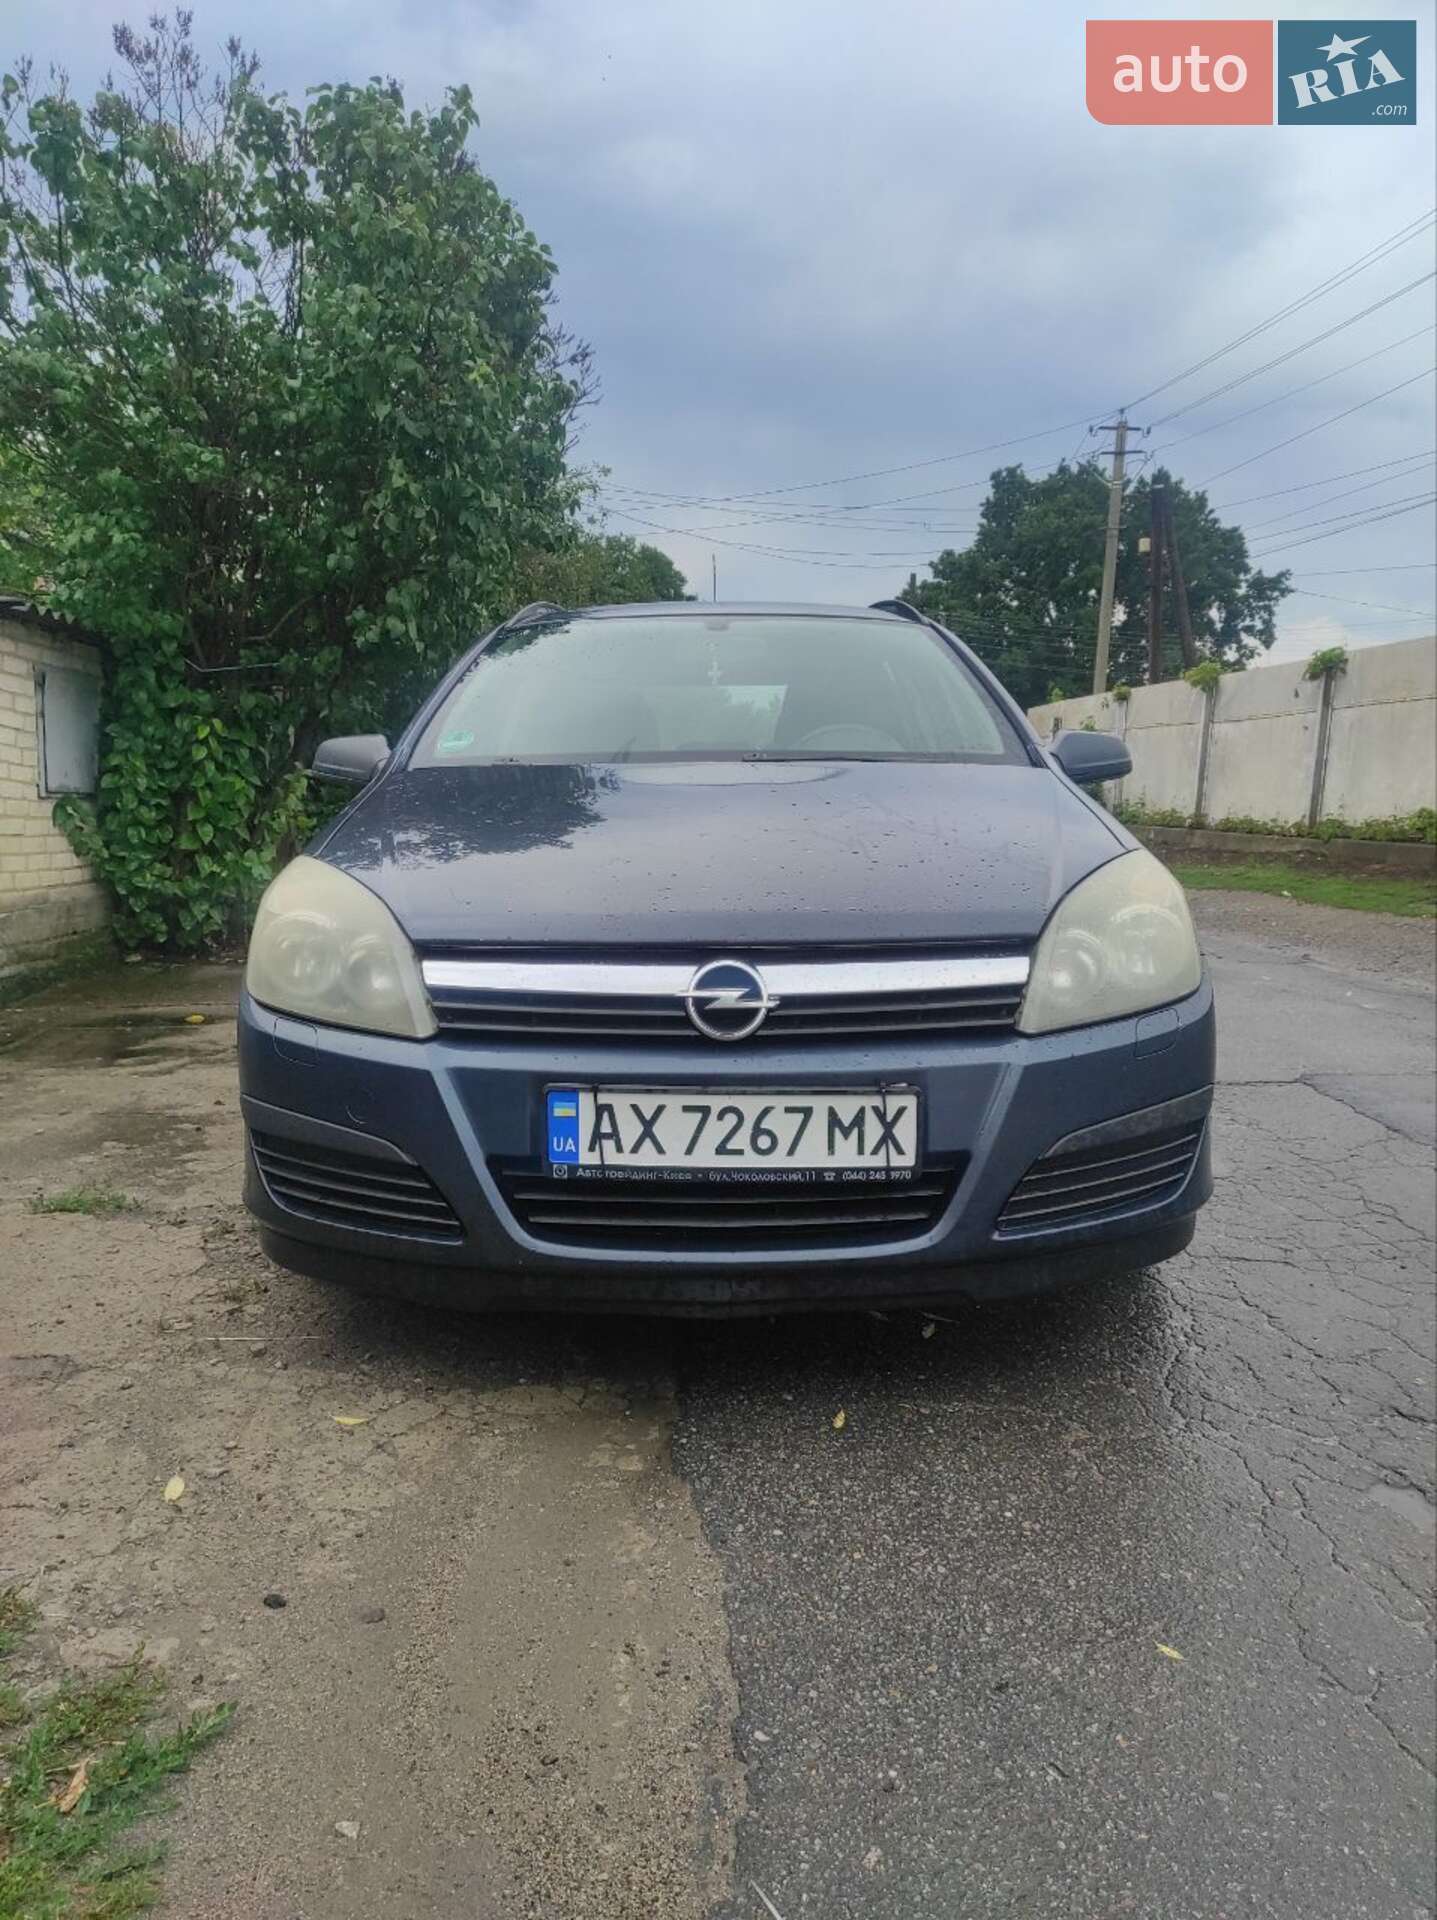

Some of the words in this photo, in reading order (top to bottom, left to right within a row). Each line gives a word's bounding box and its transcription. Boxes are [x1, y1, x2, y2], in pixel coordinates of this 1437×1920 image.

[553, 1136, 577, 1153] UA
[588, 1103, 667, 1155] AX
[681, 1105, 814, 1157] 7267
[827, 1104, 908, 1156] MX
